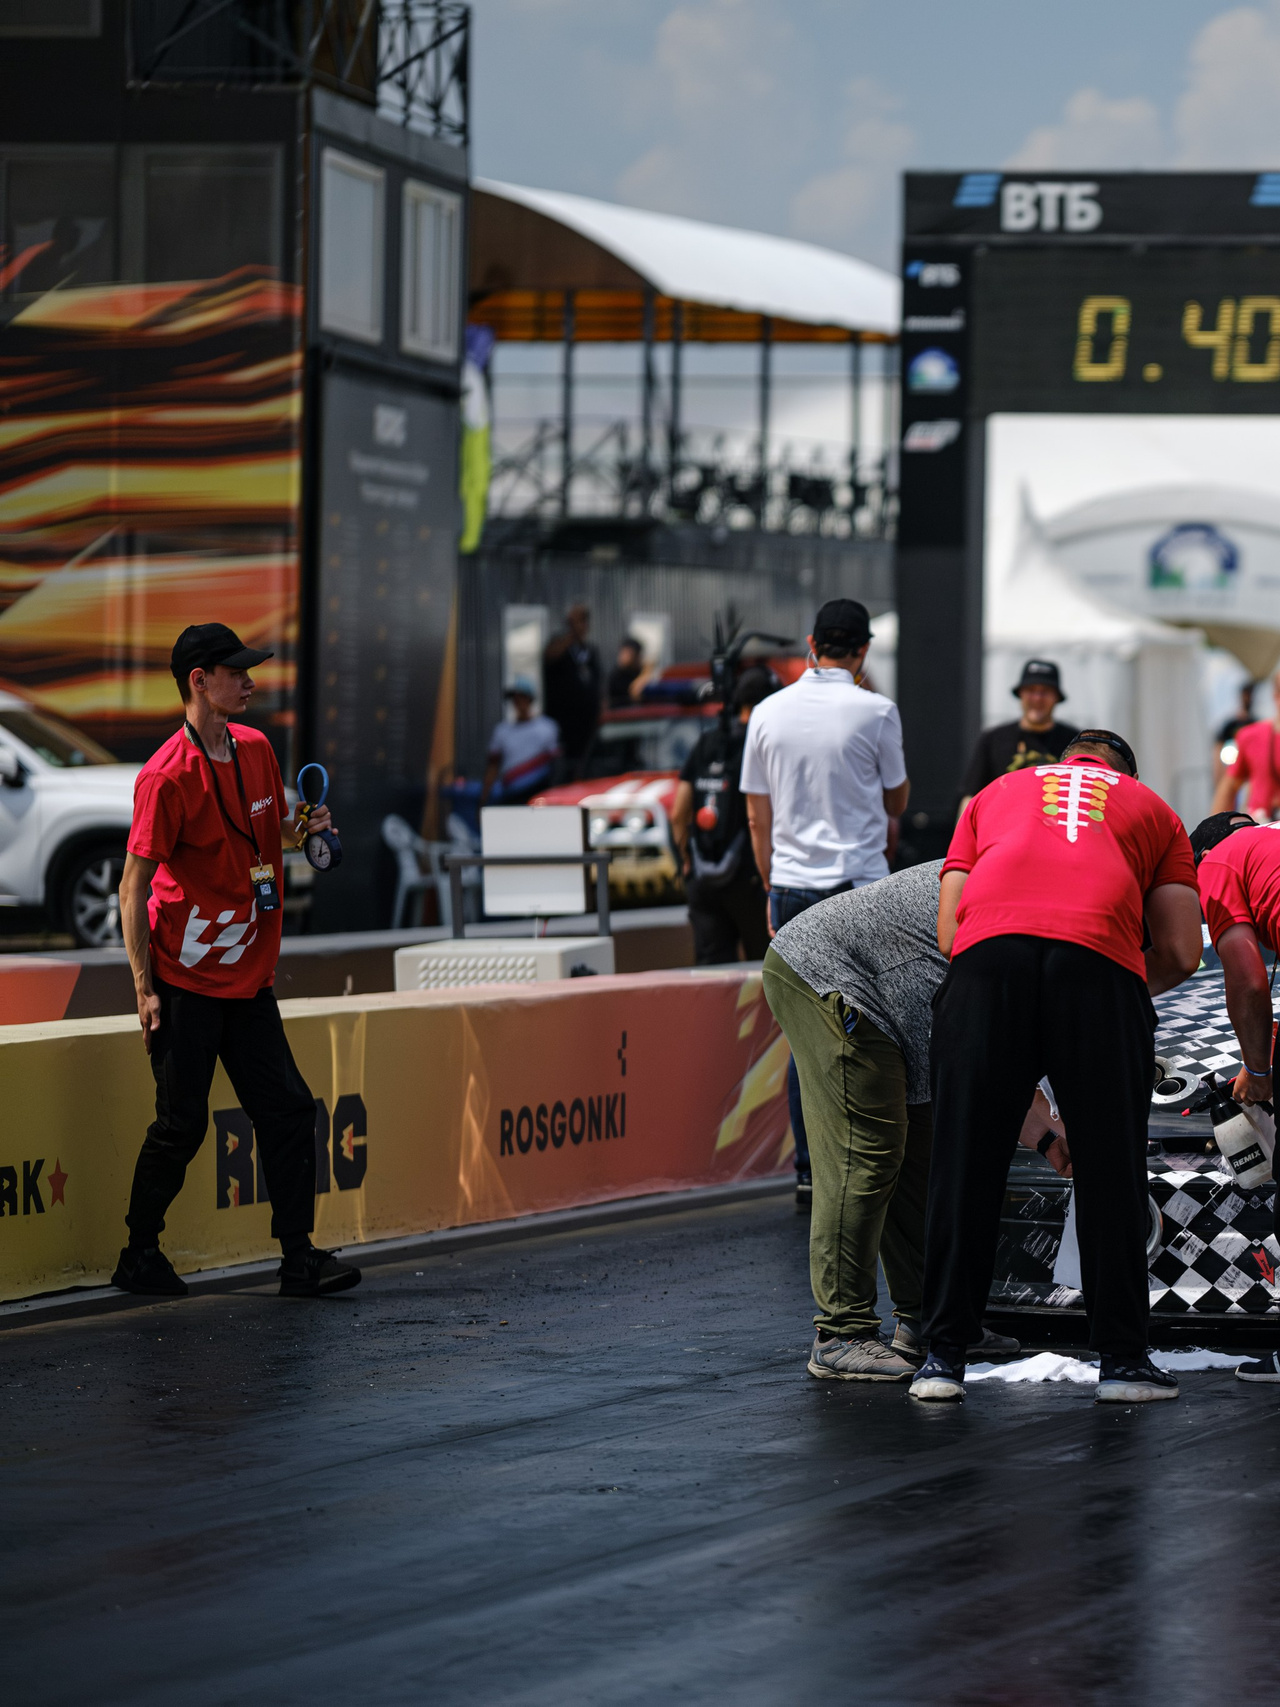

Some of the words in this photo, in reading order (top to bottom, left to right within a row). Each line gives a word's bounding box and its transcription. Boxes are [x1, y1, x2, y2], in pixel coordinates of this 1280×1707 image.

[1000, 180, 1102, 231] ВТБ
[500, 1091, 627, 1157] ROSGONKI
[1234, 1149, 1261, 1168] REMIX
